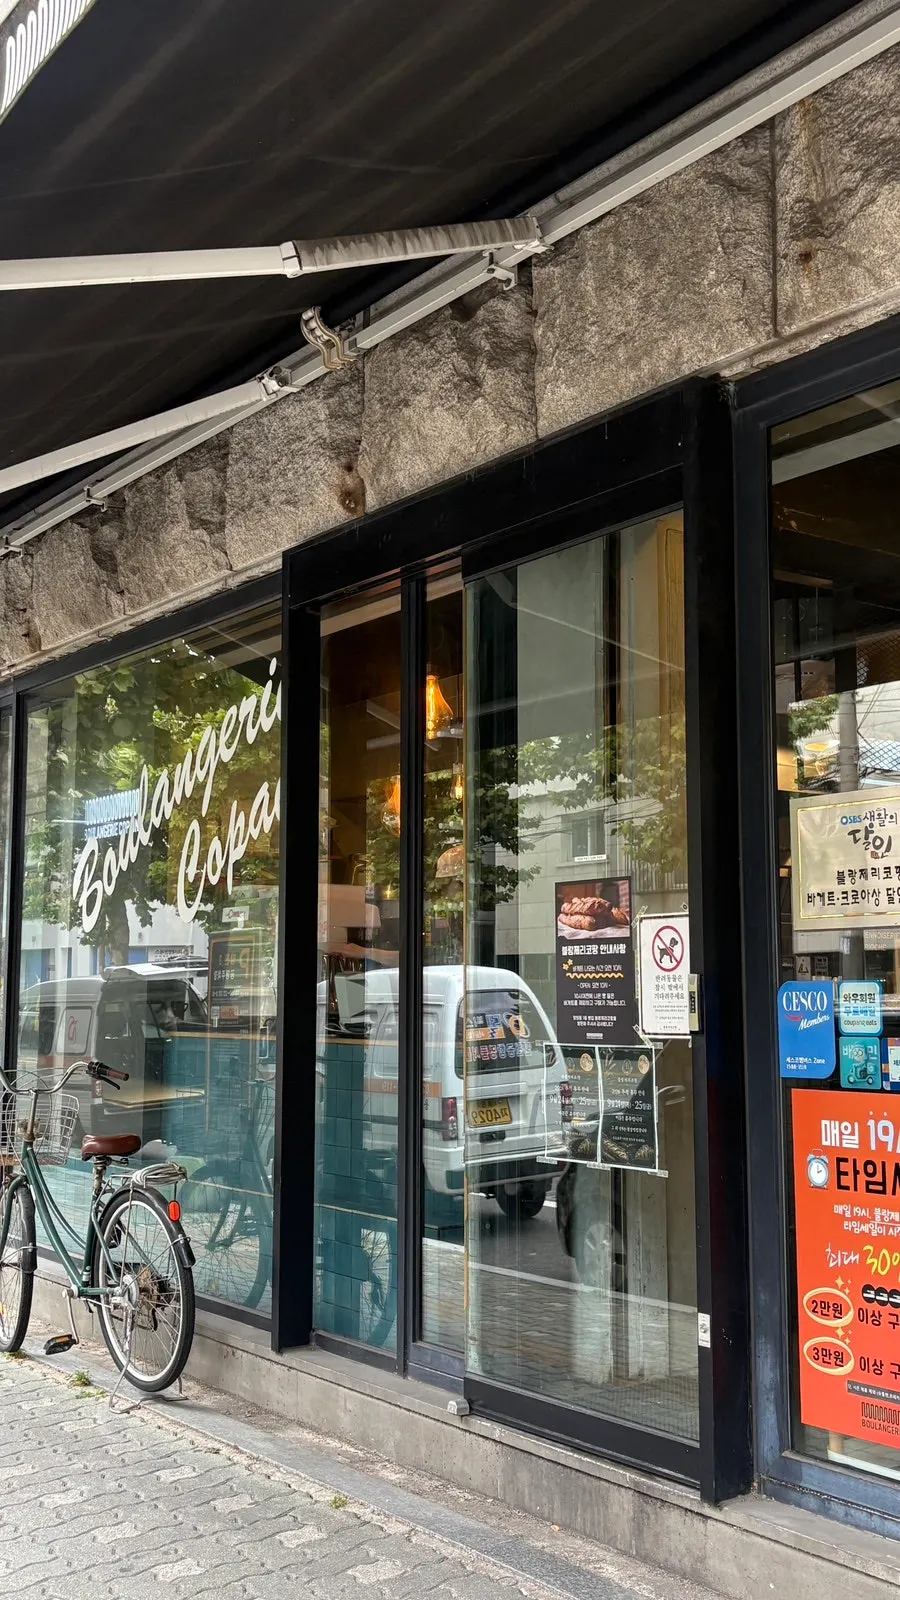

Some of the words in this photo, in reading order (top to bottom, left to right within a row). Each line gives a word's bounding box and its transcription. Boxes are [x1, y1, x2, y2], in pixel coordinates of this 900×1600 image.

[848, 814, 863, 825] SBS
[847, 825, 893, 859] 달인
[599, 944, 627, 955] 안내사항
[655, 974, 683, 983] 반려동물은
[654, 992, 685, 1000] 기다려주세요
[783, 990, 828, 1011] CESCO
[843, 993, 876, 1004] 와우회원
[798, 1012, 830, 1031] Members
[842, 1043, 878, 1060] 배민
[821, 1119, 860, 1149] 매일
[866, 1118, 900, 1154] 19
[833, 1204, 851, 1218] 매일
[843, 1220, 886, 1237] 타임세일이
[811, 1299, 844, 1319] 2만원
[857, 1307, 883, 1327] 이상
[812, 1346, 845, 1368] 3만원
[859, 1356, 884, 1377] 이상
